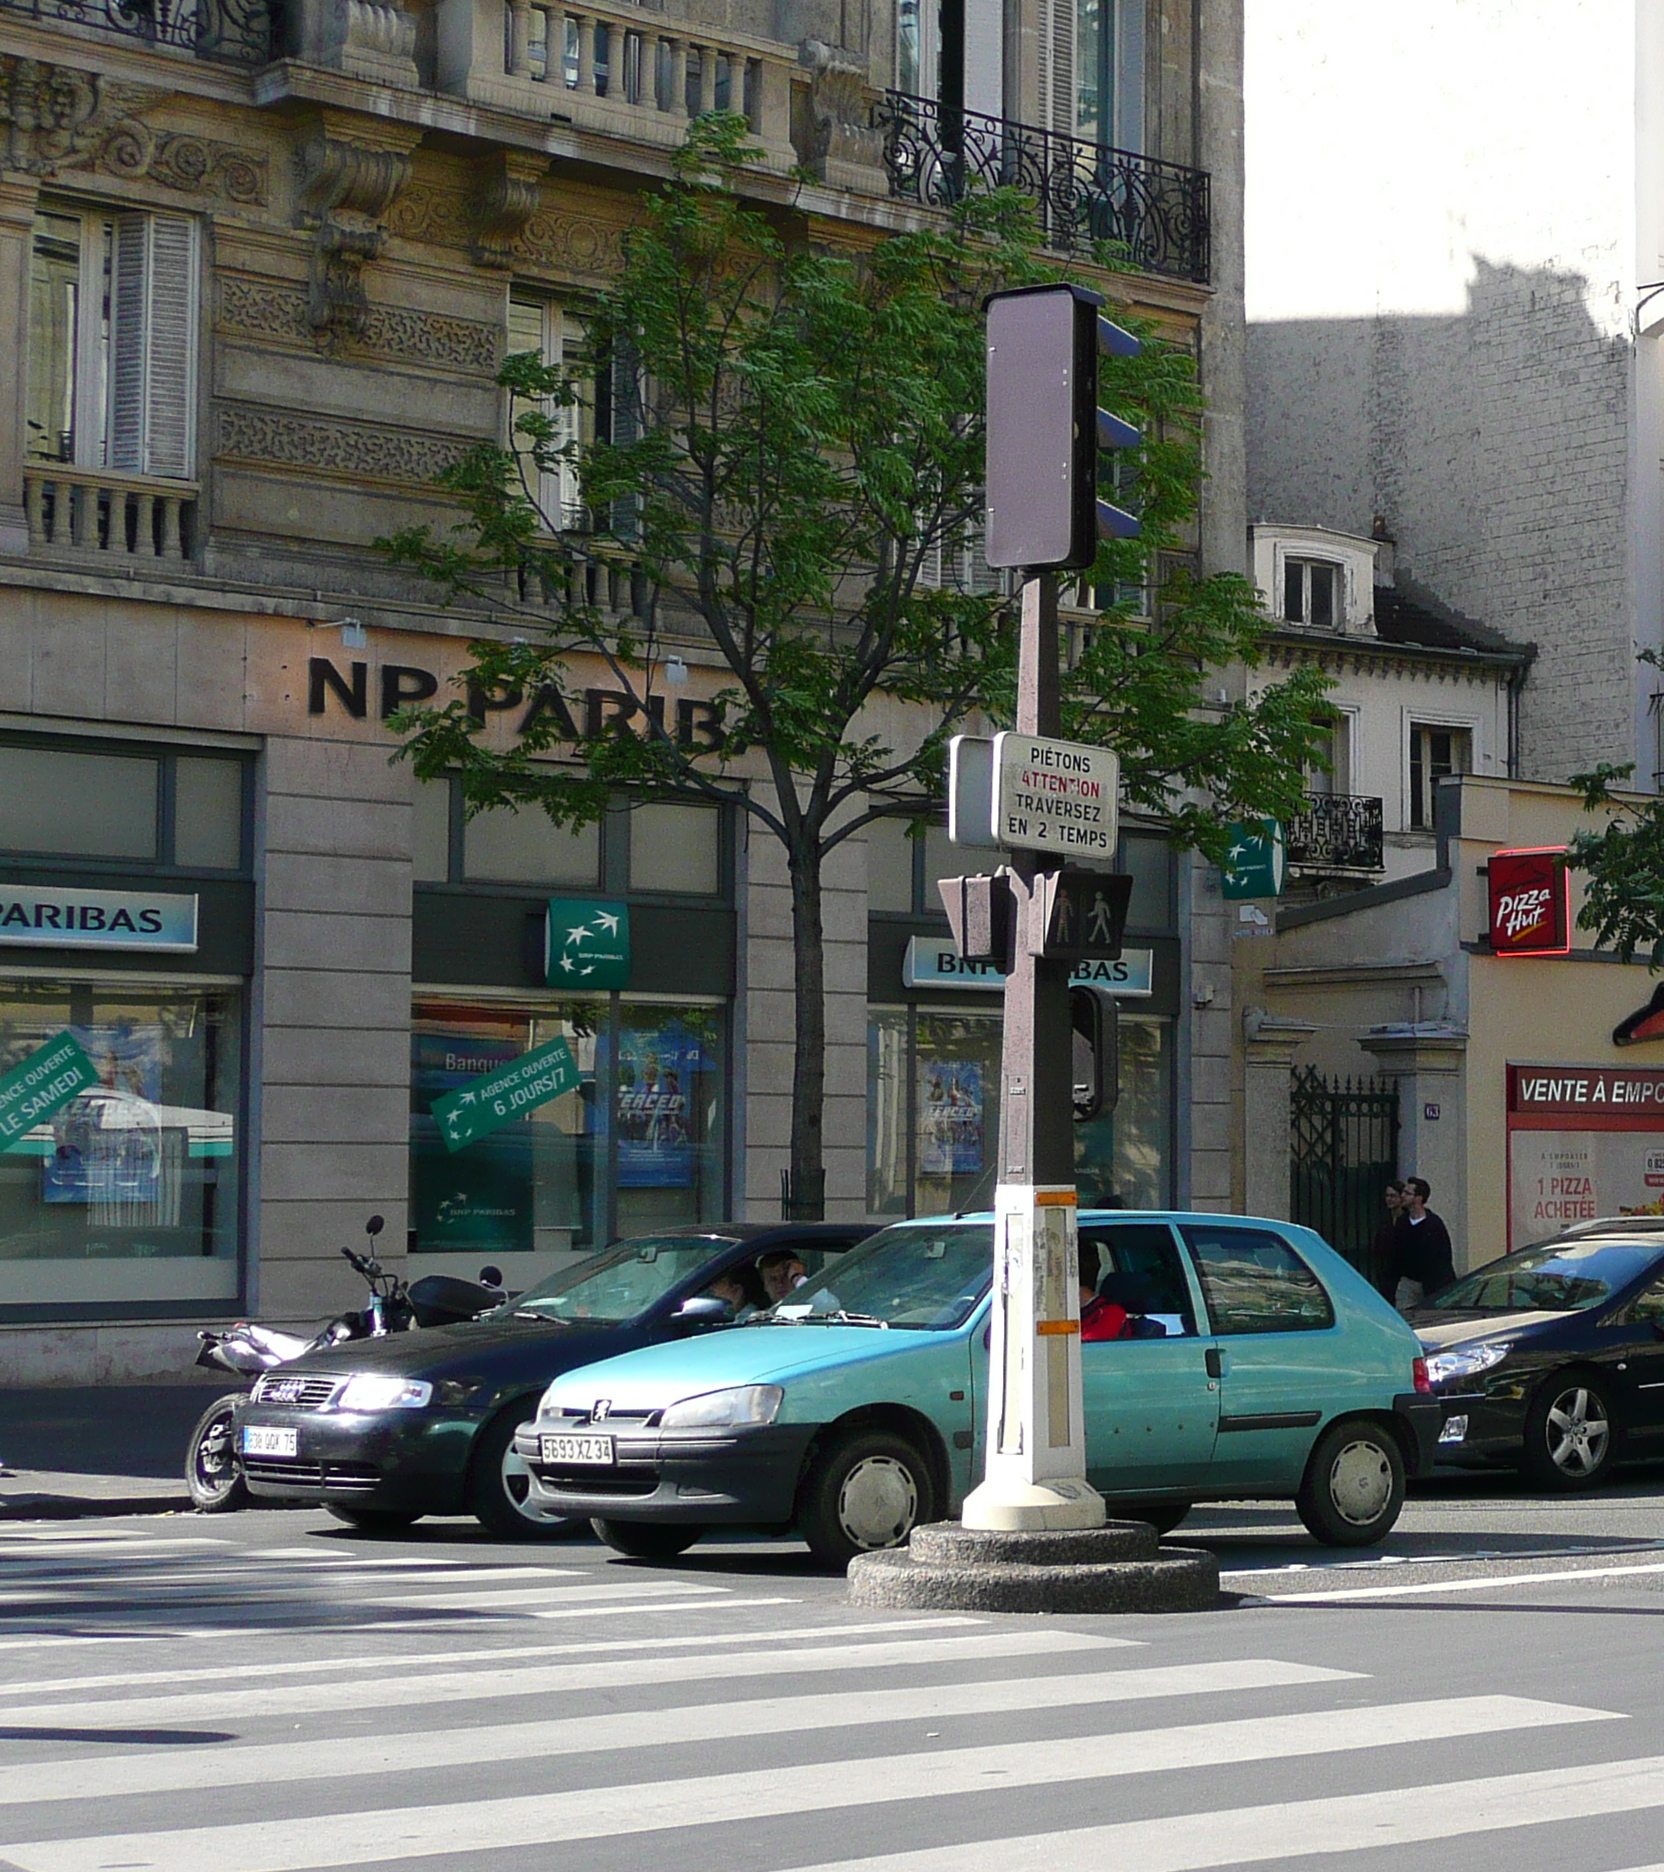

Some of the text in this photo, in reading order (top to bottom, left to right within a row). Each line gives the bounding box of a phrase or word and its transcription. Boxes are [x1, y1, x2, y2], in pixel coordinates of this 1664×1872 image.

[467, 678, 775, 757] PARIB
[1031, 746, 1091, 773] PIÉTONS
[1022, 771, 1100, 798] ATTENTION
[1016, 793, 1101, 823] TRAVERSEZ
[1008, 817, 1107, 848] EN 2 TEMPS
[0, 902, 163, 934] ARIBAS
[1496, 888, 1551, 929] Pizza
[1505, 905, 1546, 937] Hut
[25, 1044, 76, 1086] OUVERTE
[480, 1047, 568, 1101] AGENCE OUVERTE
[0, 1112, 23, 1136] LE
[21, 1066, 84, 1119] SAMEDI
[494, 1067, 566, 1116] 6 JOURS/7
[1521, 1079, 1588, 1102] VENTE
[1592, 1075, 1606, 1103] À
[1647, 1158, 1652, 1168] 0
[1537, 1177, 1592, 1195] 1 PIZZA
[1534, 1196, 1595, 1219] ACHETÉE
[284, 1433, 296, 1451] 75
[543, 1438, 575, 1459] 5693
[576, 1438, 593, 1460] XZ
